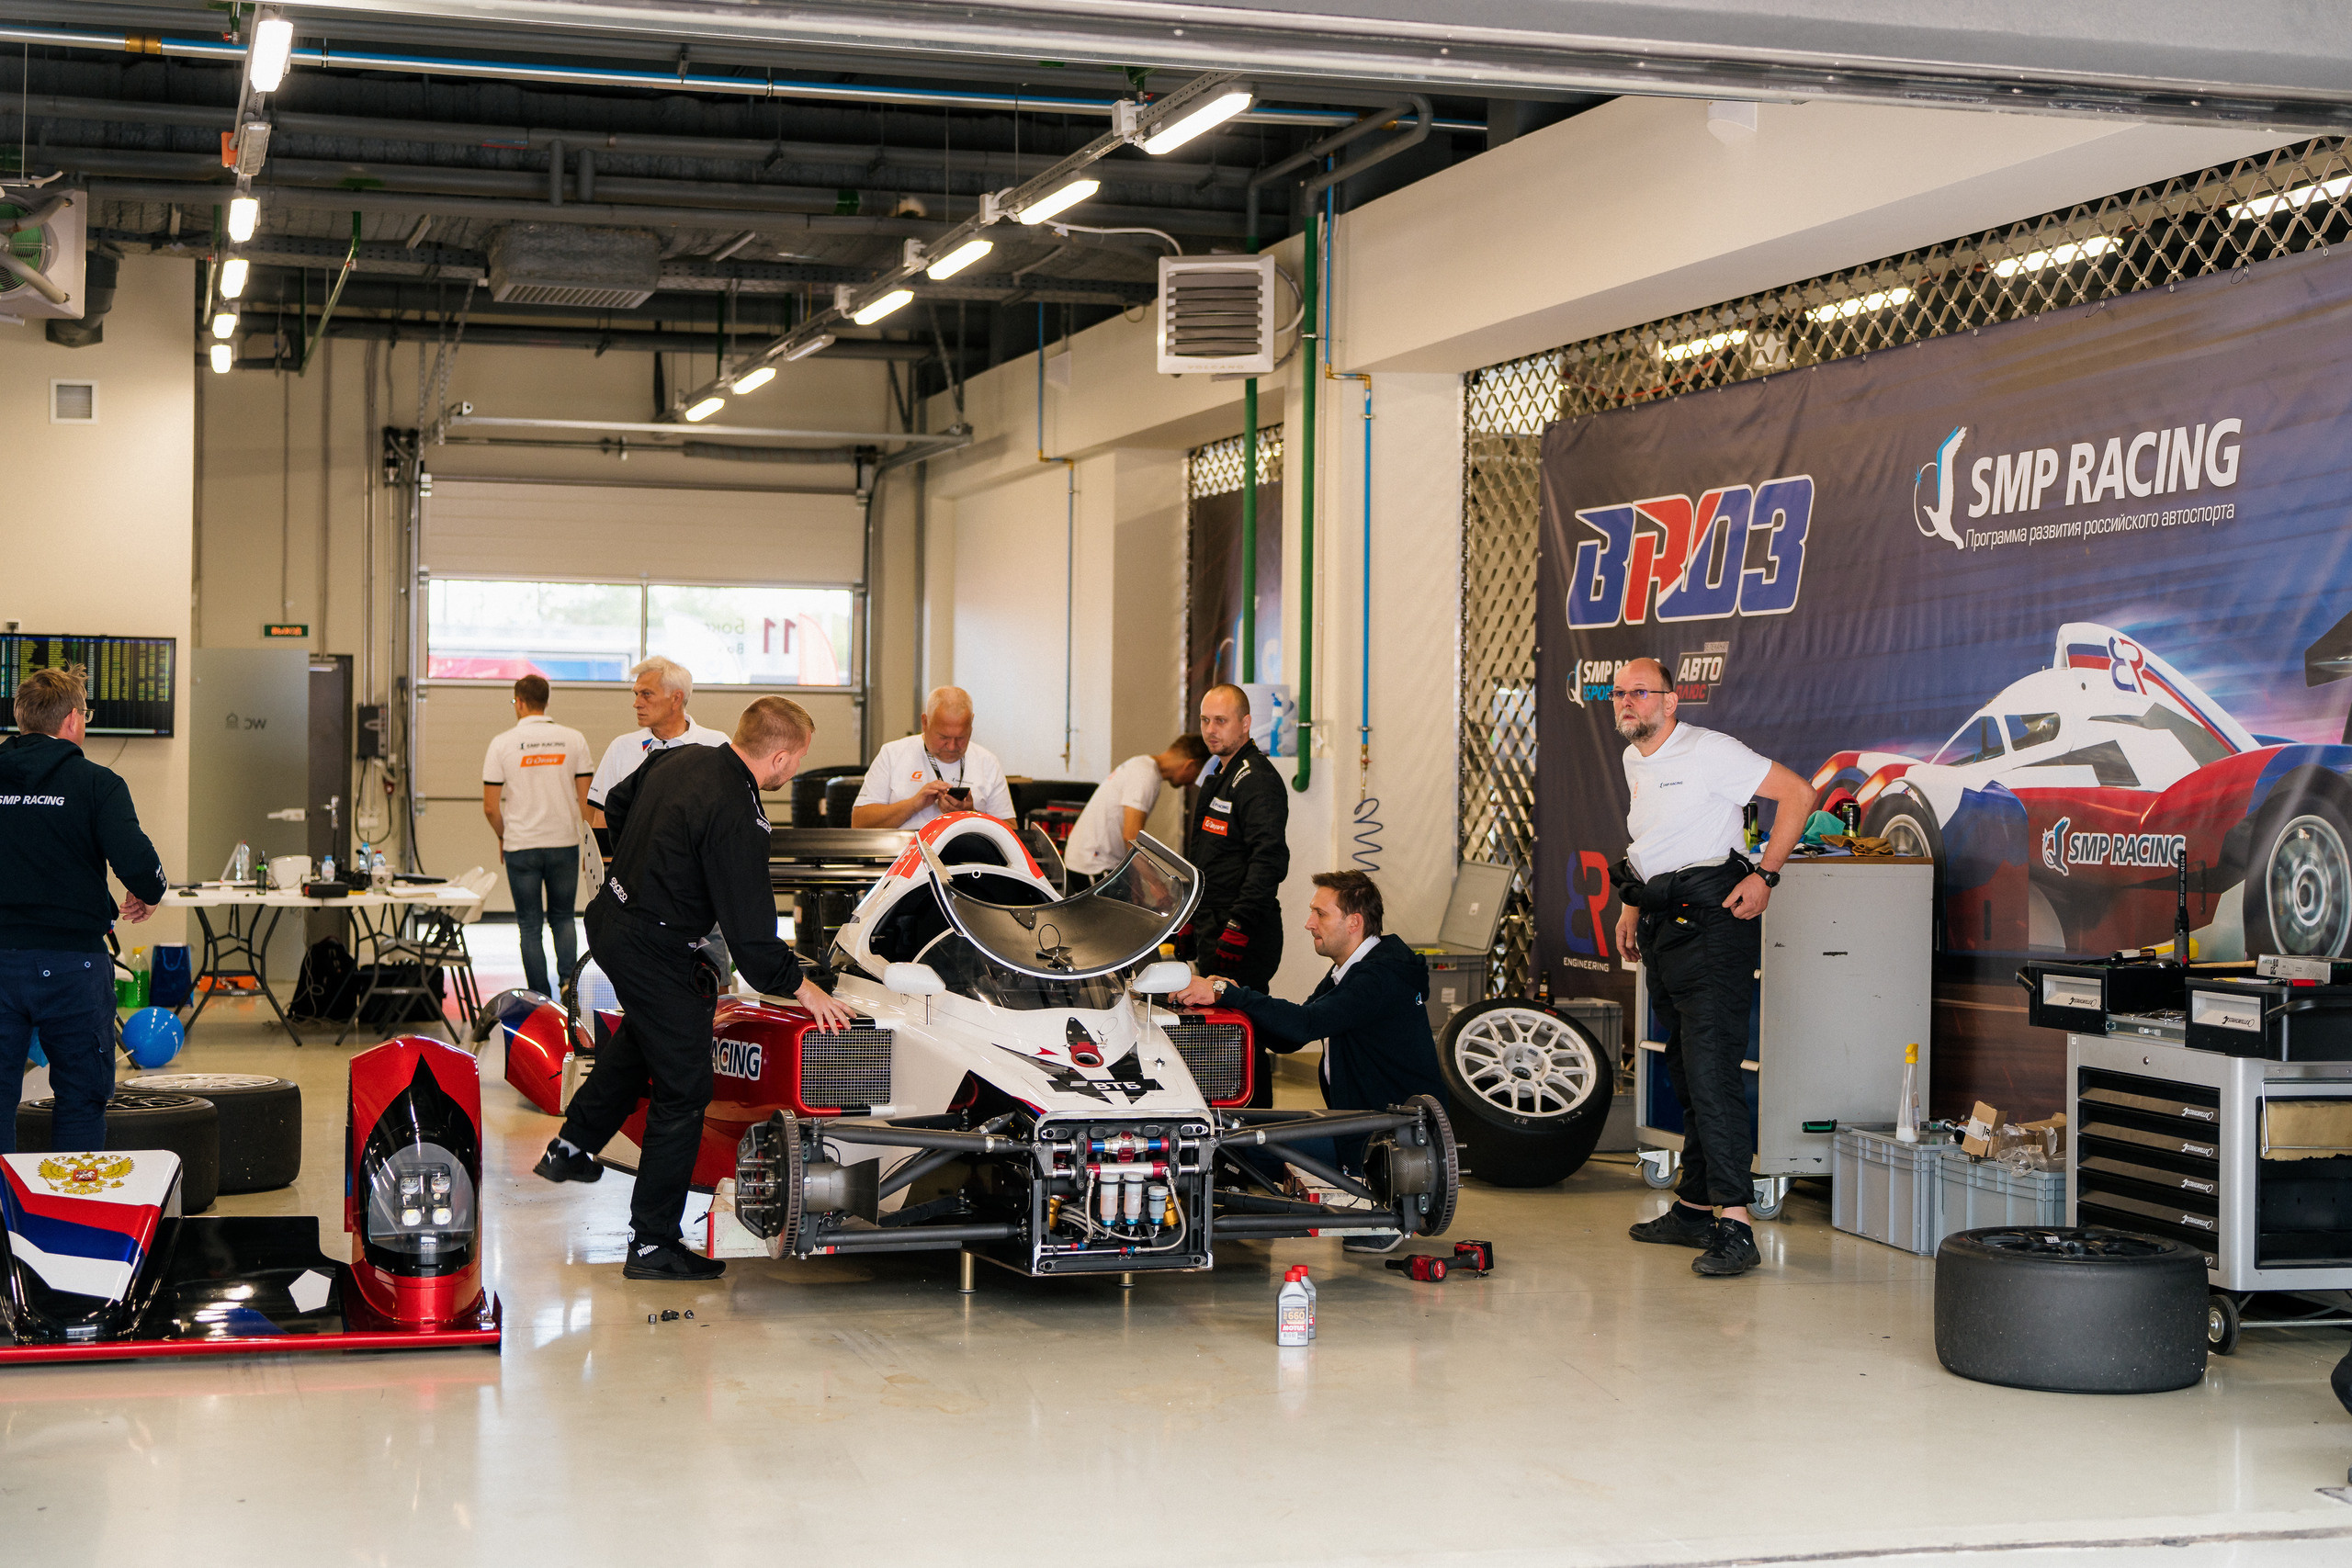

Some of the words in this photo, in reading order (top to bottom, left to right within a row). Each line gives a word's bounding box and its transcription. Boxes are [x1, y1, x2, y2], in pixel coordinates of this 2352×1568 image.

[1968, 447, 2059, 518] SMP
[2065, 418, 2243, 506] RACING
[1965, 527, 2027, 551] Программа
[2030, 521, 2081, 546] развития
[2084, 513, 2158, 540] российского
[2161, 502, 2235, 526] автоспорта
[1582, 660, 1612, 683] SMP
[1677, 656, 1724, 682] АВТО
[22, 795, 65, 807] RACING
[2067, 832, 2110, 864] SMP
[2110, 833, 2186, 868] RACING
[1563, 956, 1611, 973] ENGINEERING
[713, 1036, 762, 1080] ACING
[1091, 1081, 1142, 1090] ВТБ
[1288, 1311, 1306, 1320] 660
